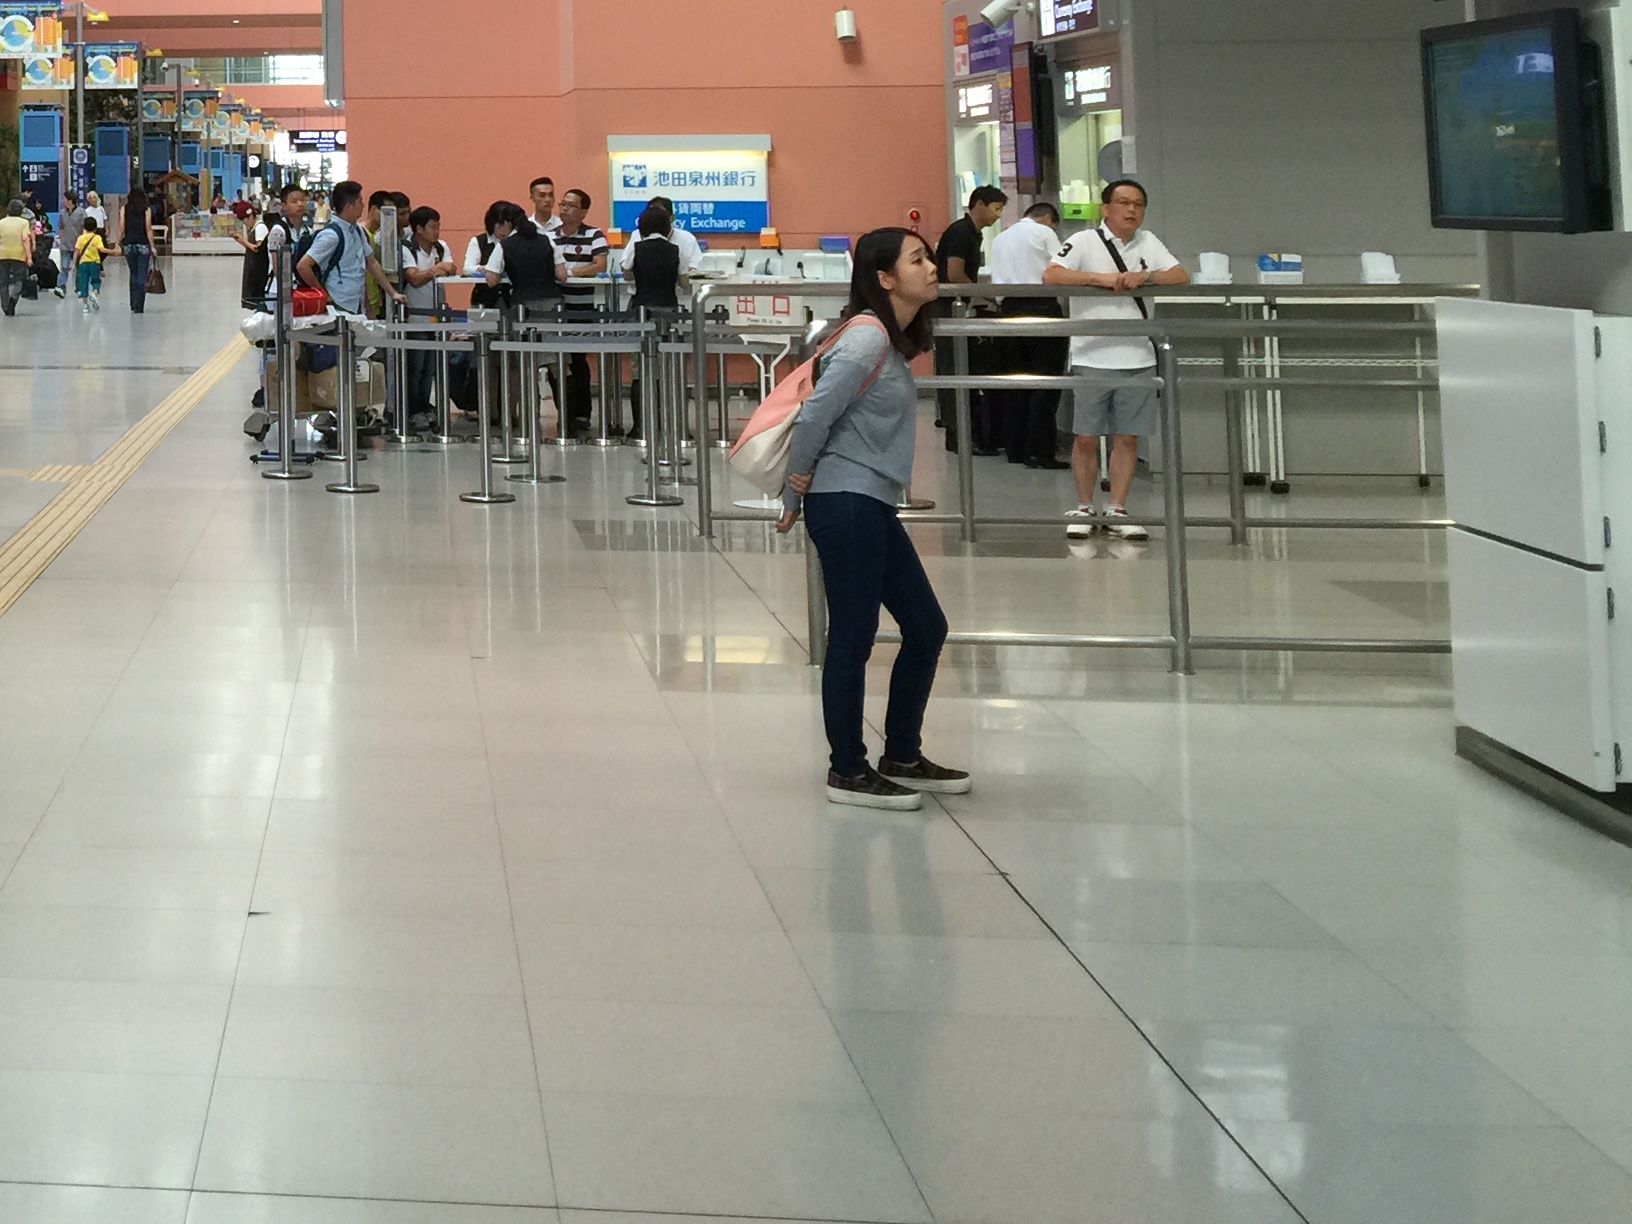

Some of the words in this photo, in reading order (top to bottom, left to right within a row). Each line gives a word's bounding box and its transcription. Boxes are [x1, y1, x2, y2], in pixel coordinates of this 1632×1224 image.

[653, 171, 756, 187] 池田泉州銀行
[690, 216, 747, 231] Exchange
[1057, 242, 1074, 258] 3
